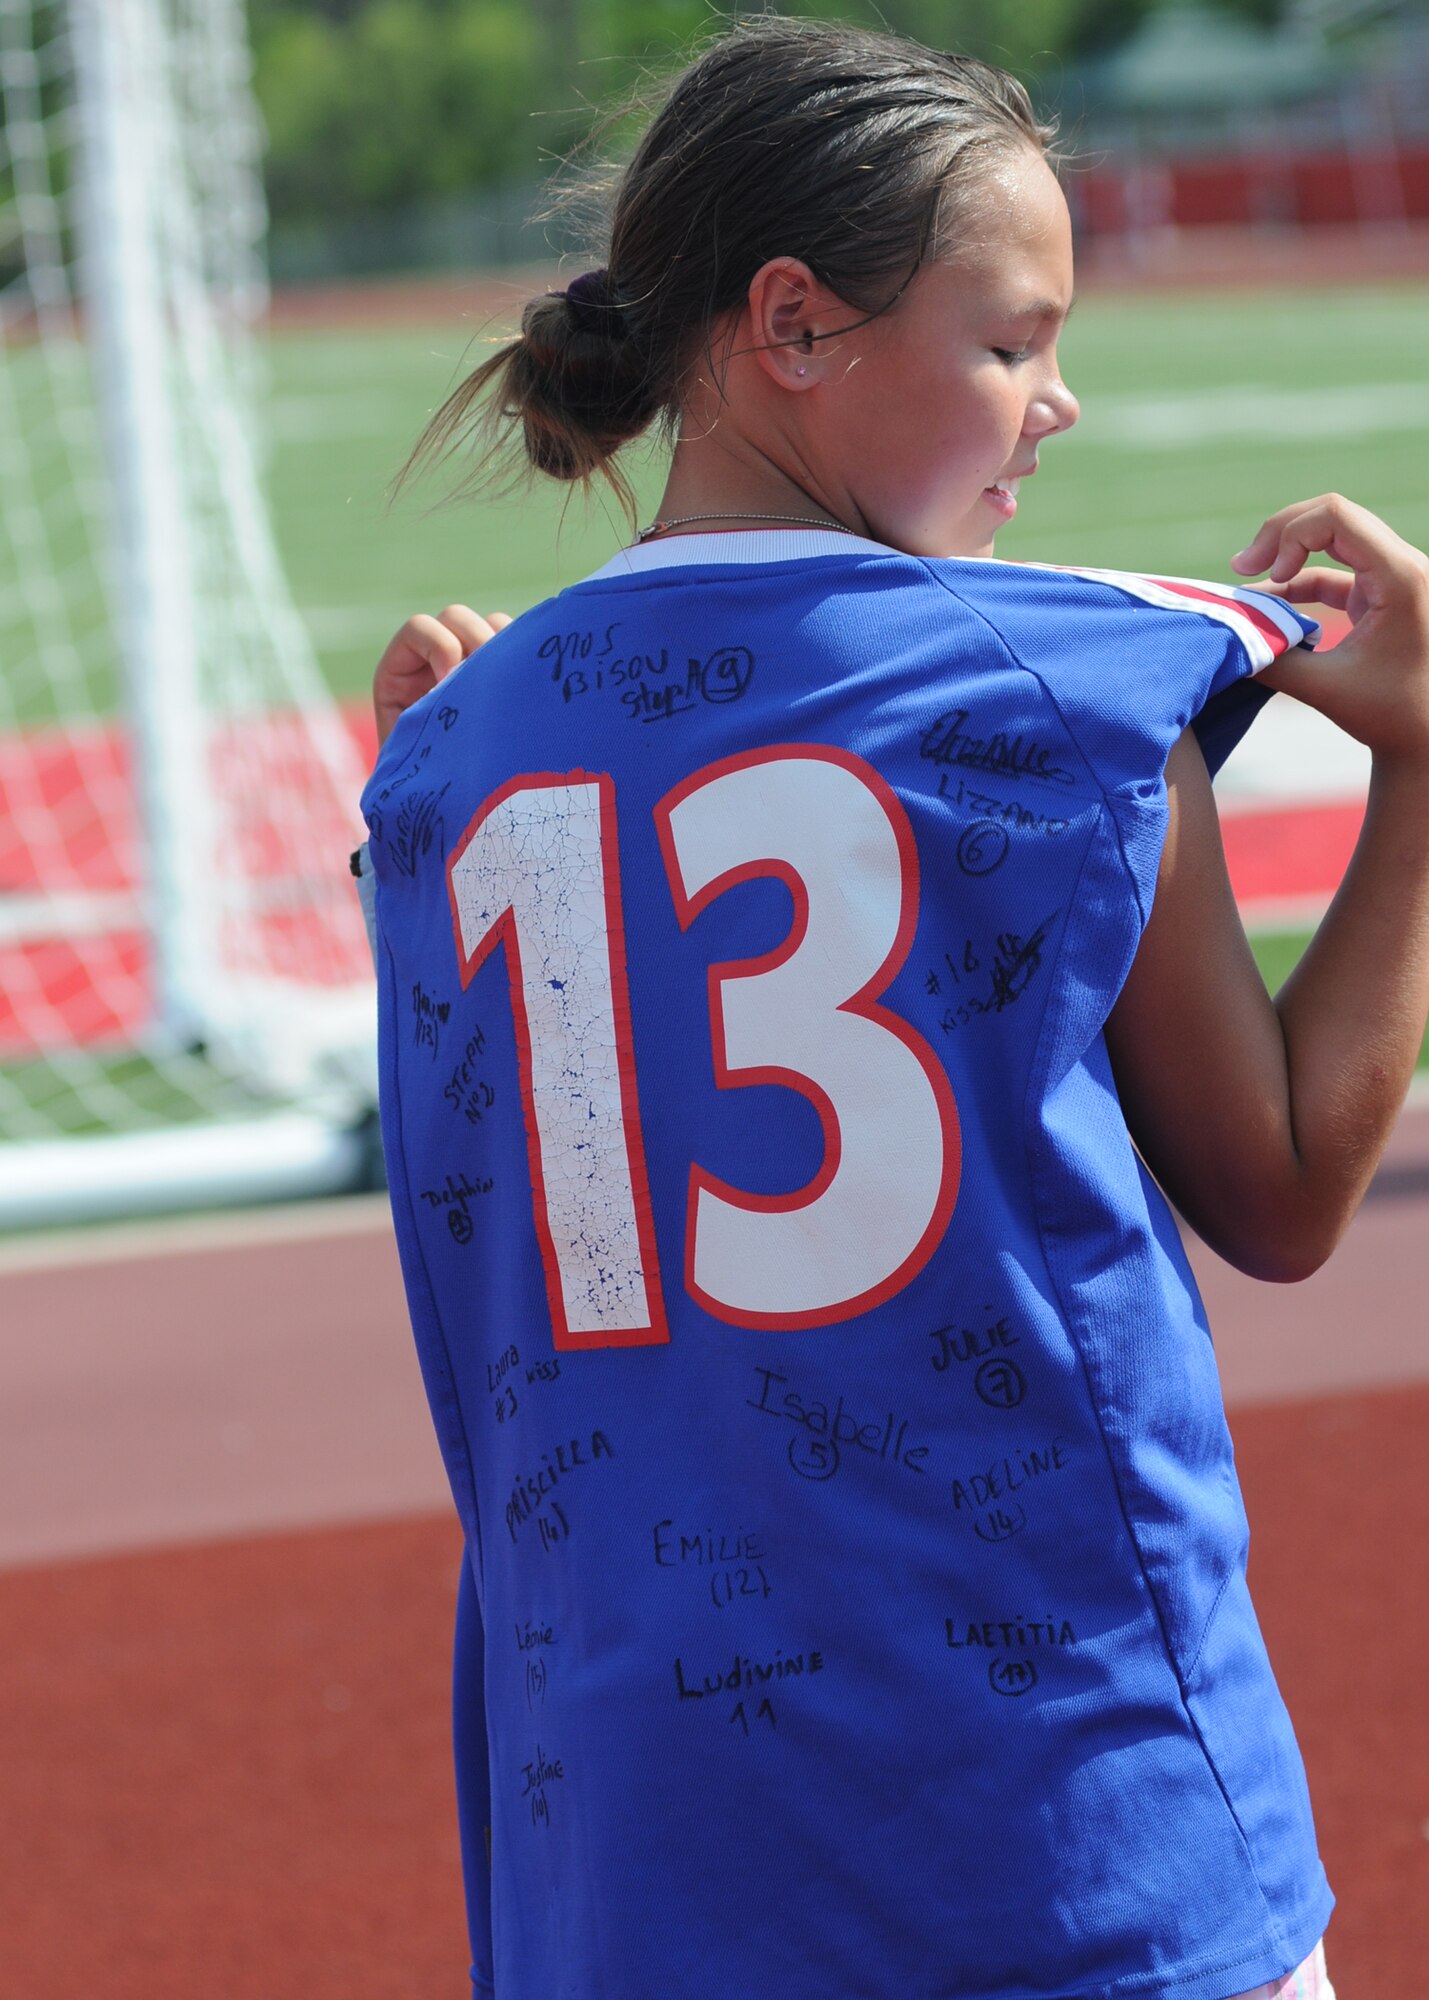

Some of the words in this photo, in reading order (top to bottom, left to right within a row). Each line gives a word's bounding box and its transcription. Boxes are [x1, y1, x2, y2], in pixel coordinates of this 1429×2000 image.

[437, 704, 461, 732] 8
[925, 939, 980, 996] #16
[446, 742, 962, 1351] 13
[929, 1303, 1021, 1372] JULIE
[746, 1366, 929, 1474] Isabelle
[730, 1698, 776, 1737] 11
